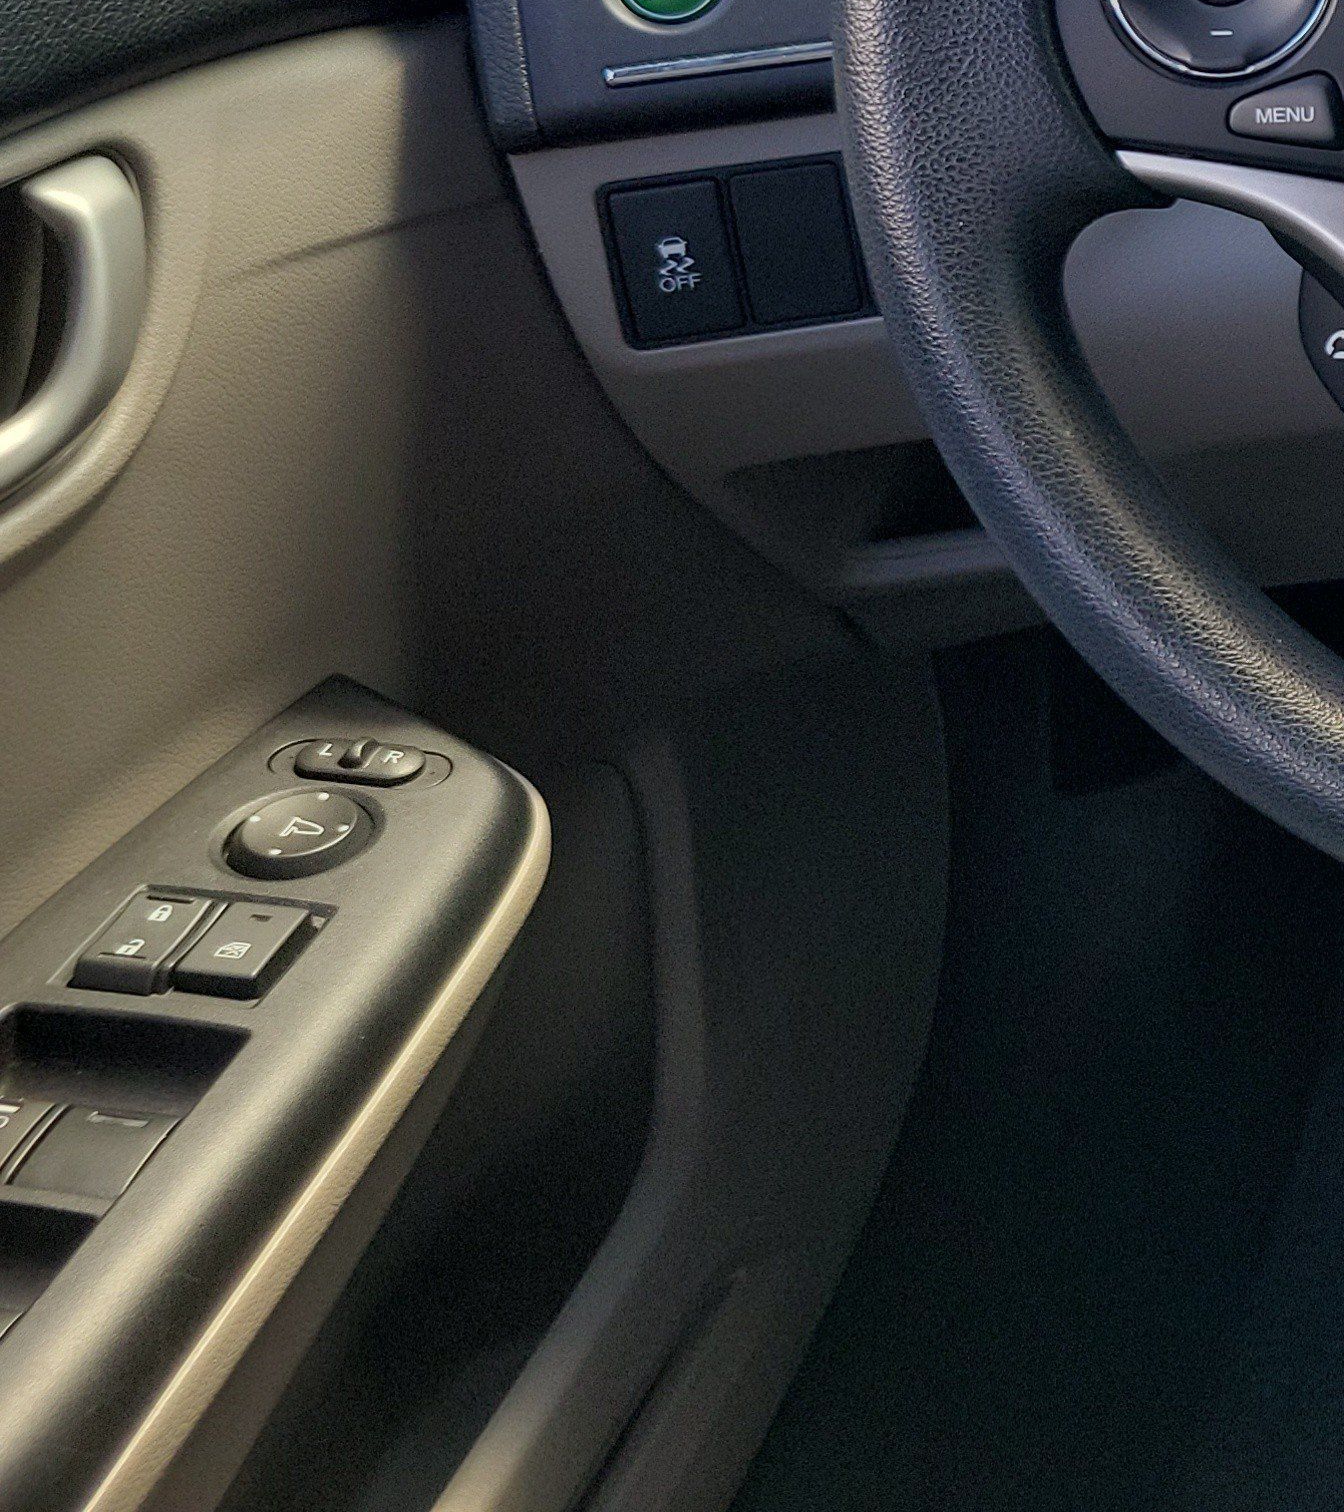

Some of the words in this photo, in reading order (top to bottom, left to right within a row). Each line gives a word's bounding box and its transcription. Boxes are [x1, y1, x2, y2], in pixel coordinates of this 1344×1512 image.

[1255, 105, 1315, 125] MENU
[658, 272, 702, 293] OFF
[318, 742, 333, 757] L
[382, 749, 405, 764] R
